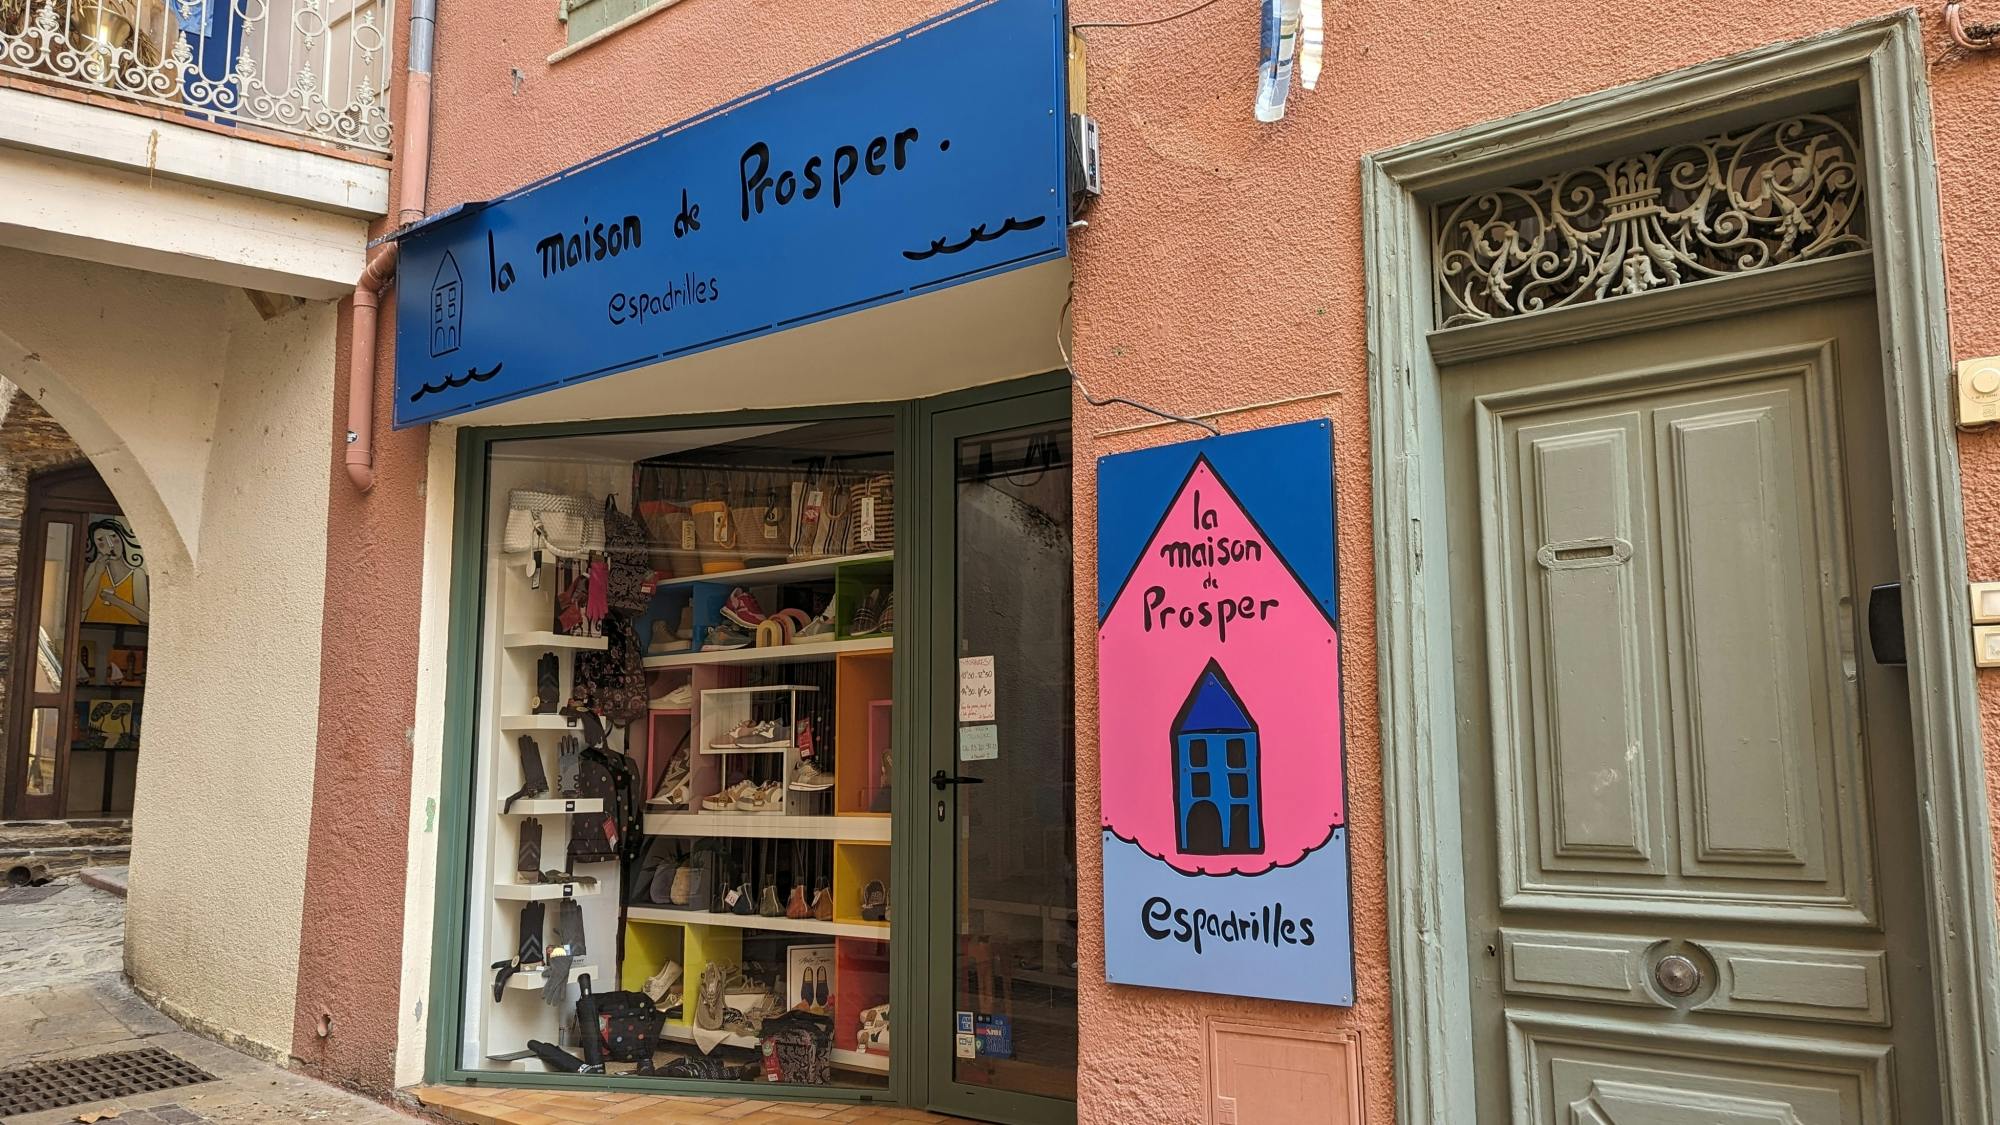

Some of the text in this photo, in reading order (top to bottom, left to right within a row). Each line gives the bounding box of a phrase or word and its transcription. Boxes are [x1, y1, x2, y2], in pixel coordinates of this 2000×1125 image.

[487, 229, 516, 294] la
[535, 214, 642, 280] maison
[672, 188, 702, 239] de
[608, 272, 720, 326] espadrilles
[1193, 490, 1218, 530] la
[1160, 537, 1263, 572] maison
[1202, 573, 1219, 590] de
[1142, 585, 1280, 644] Prosper
[1141, 896, 1316, 955] espadrilles
